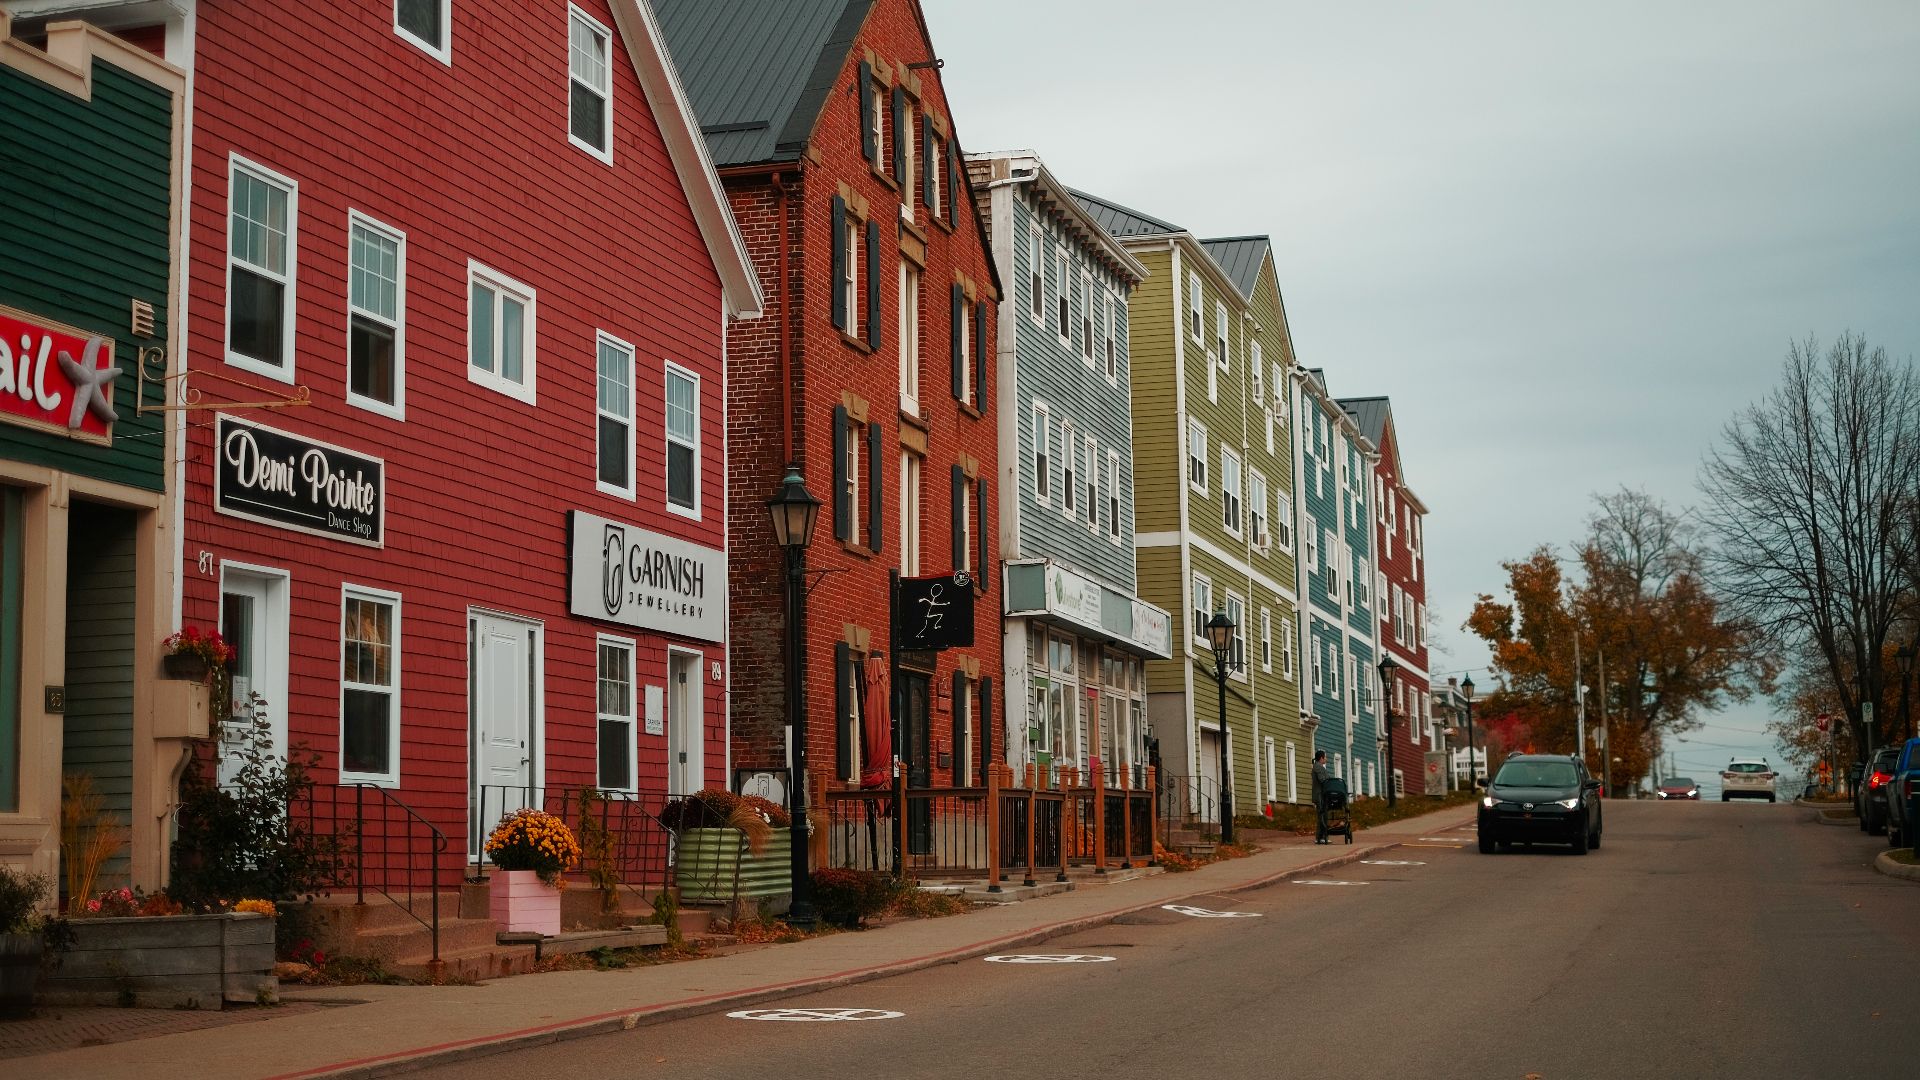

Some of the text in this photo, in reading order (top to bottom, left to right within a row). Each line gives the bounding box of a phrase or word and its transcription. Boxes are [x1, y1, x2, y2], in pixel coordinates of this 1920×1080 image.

[225, 429, 374, 515] Demi Pointe
[199, 550, 214, 576] 87
[629, 543, 704, 599] GARNISH
[628, 591, 703, 619] JEWELLERY
[711, 661, 722, 681] 89
